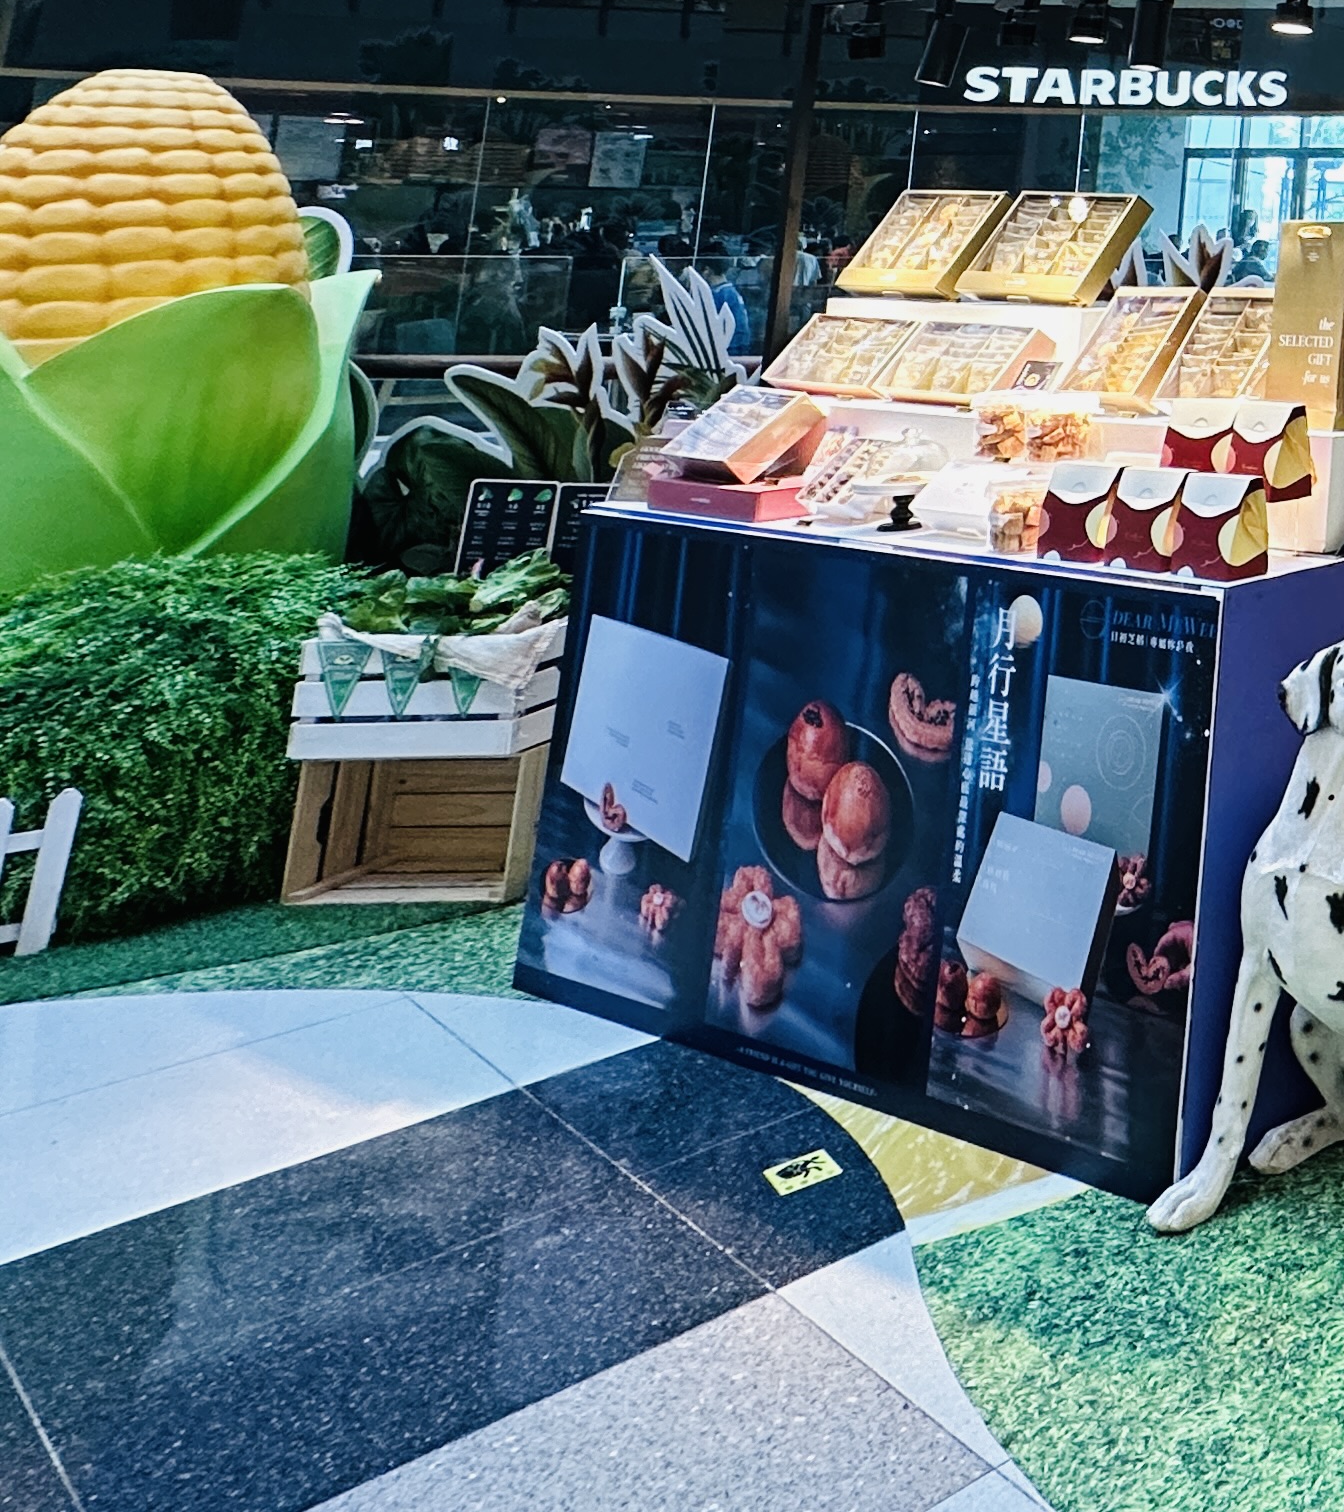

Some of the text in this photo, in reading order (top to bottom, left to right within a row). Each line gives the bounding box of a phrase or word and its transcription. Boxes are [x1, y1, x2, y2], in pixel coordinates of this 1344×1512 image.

[963, 65, 1288, 108] STARBUCKS
[1319, 317, 1335, 331] the
[1278, 334, 1334, 348] SELECTED
[1308, 353, 1332, 366] GIFT
[1301, 370, 1317, 386] for
[978, 606, 1017, 792] 月行星語
